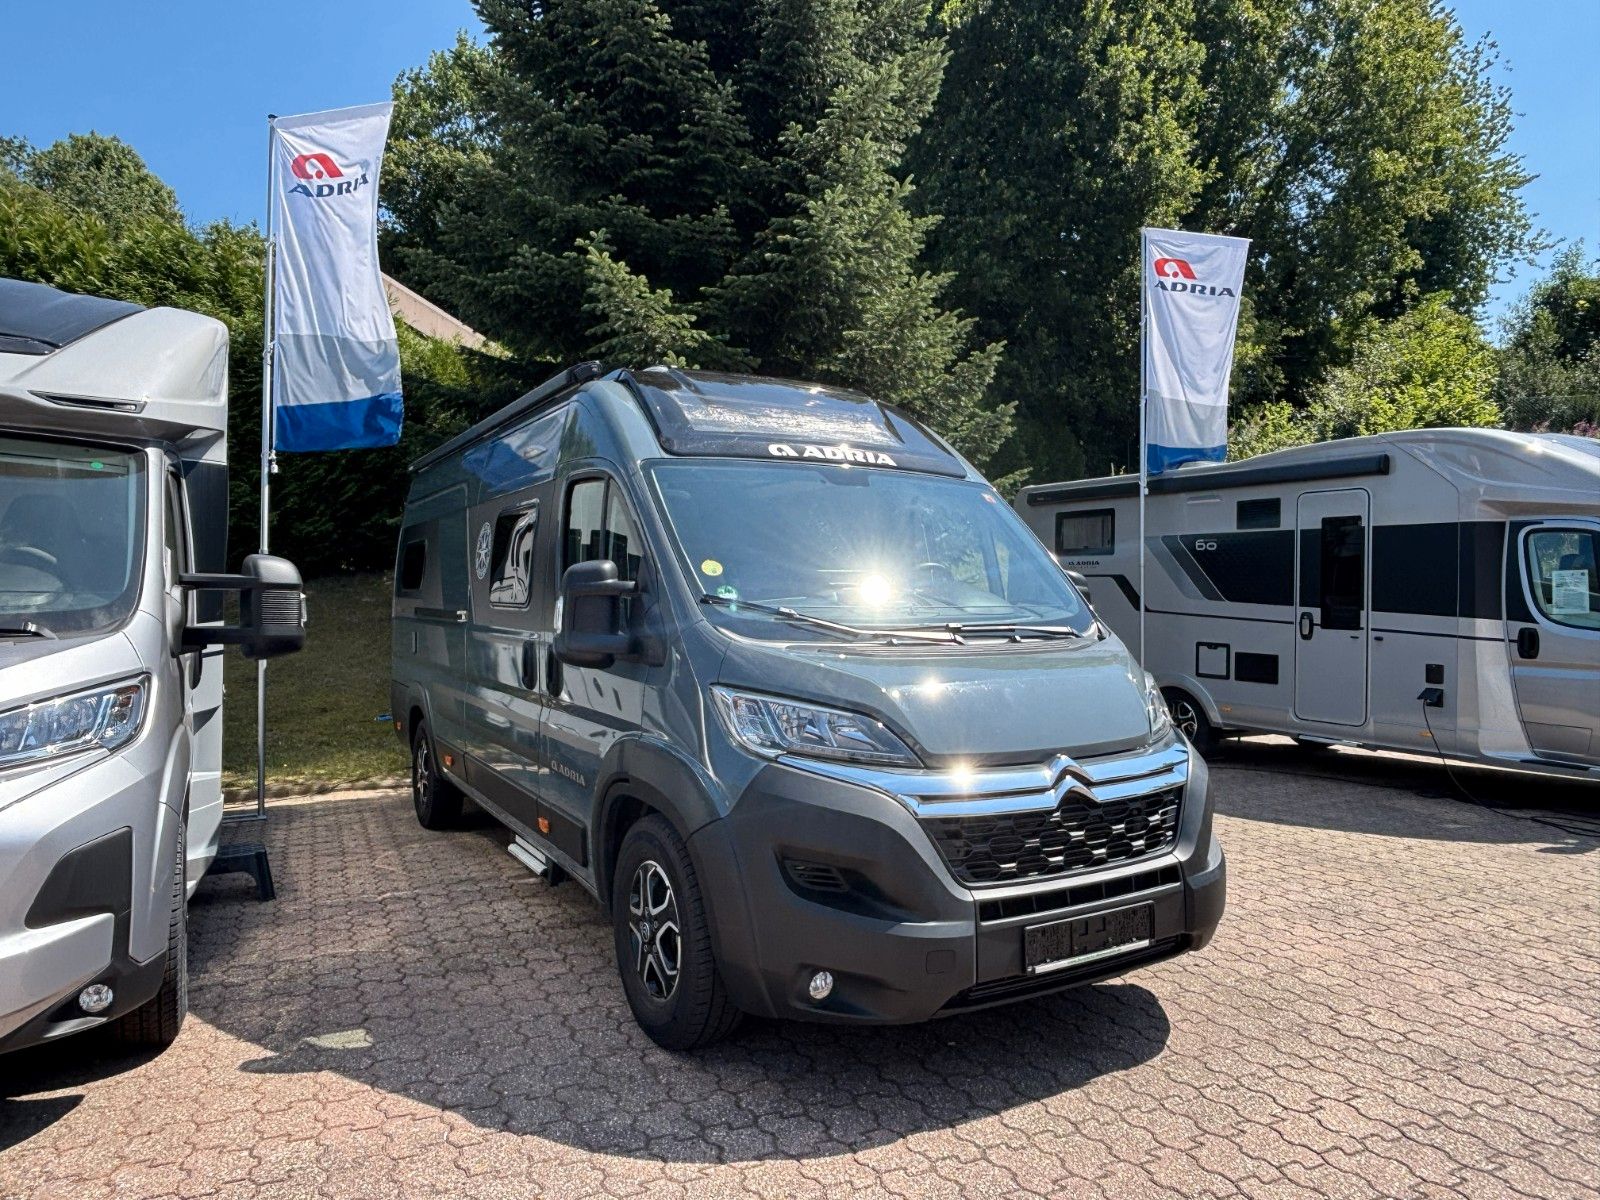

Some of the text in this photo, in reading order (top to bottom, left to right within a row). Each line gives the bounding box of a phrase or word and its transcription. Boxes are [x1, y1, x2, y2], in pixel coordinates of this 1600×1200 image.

[288, 173, 370, 198] ADRIA
[1154, 280, 1236, 298] ADRIA
[803, 445, 898, 467] ADRIA
